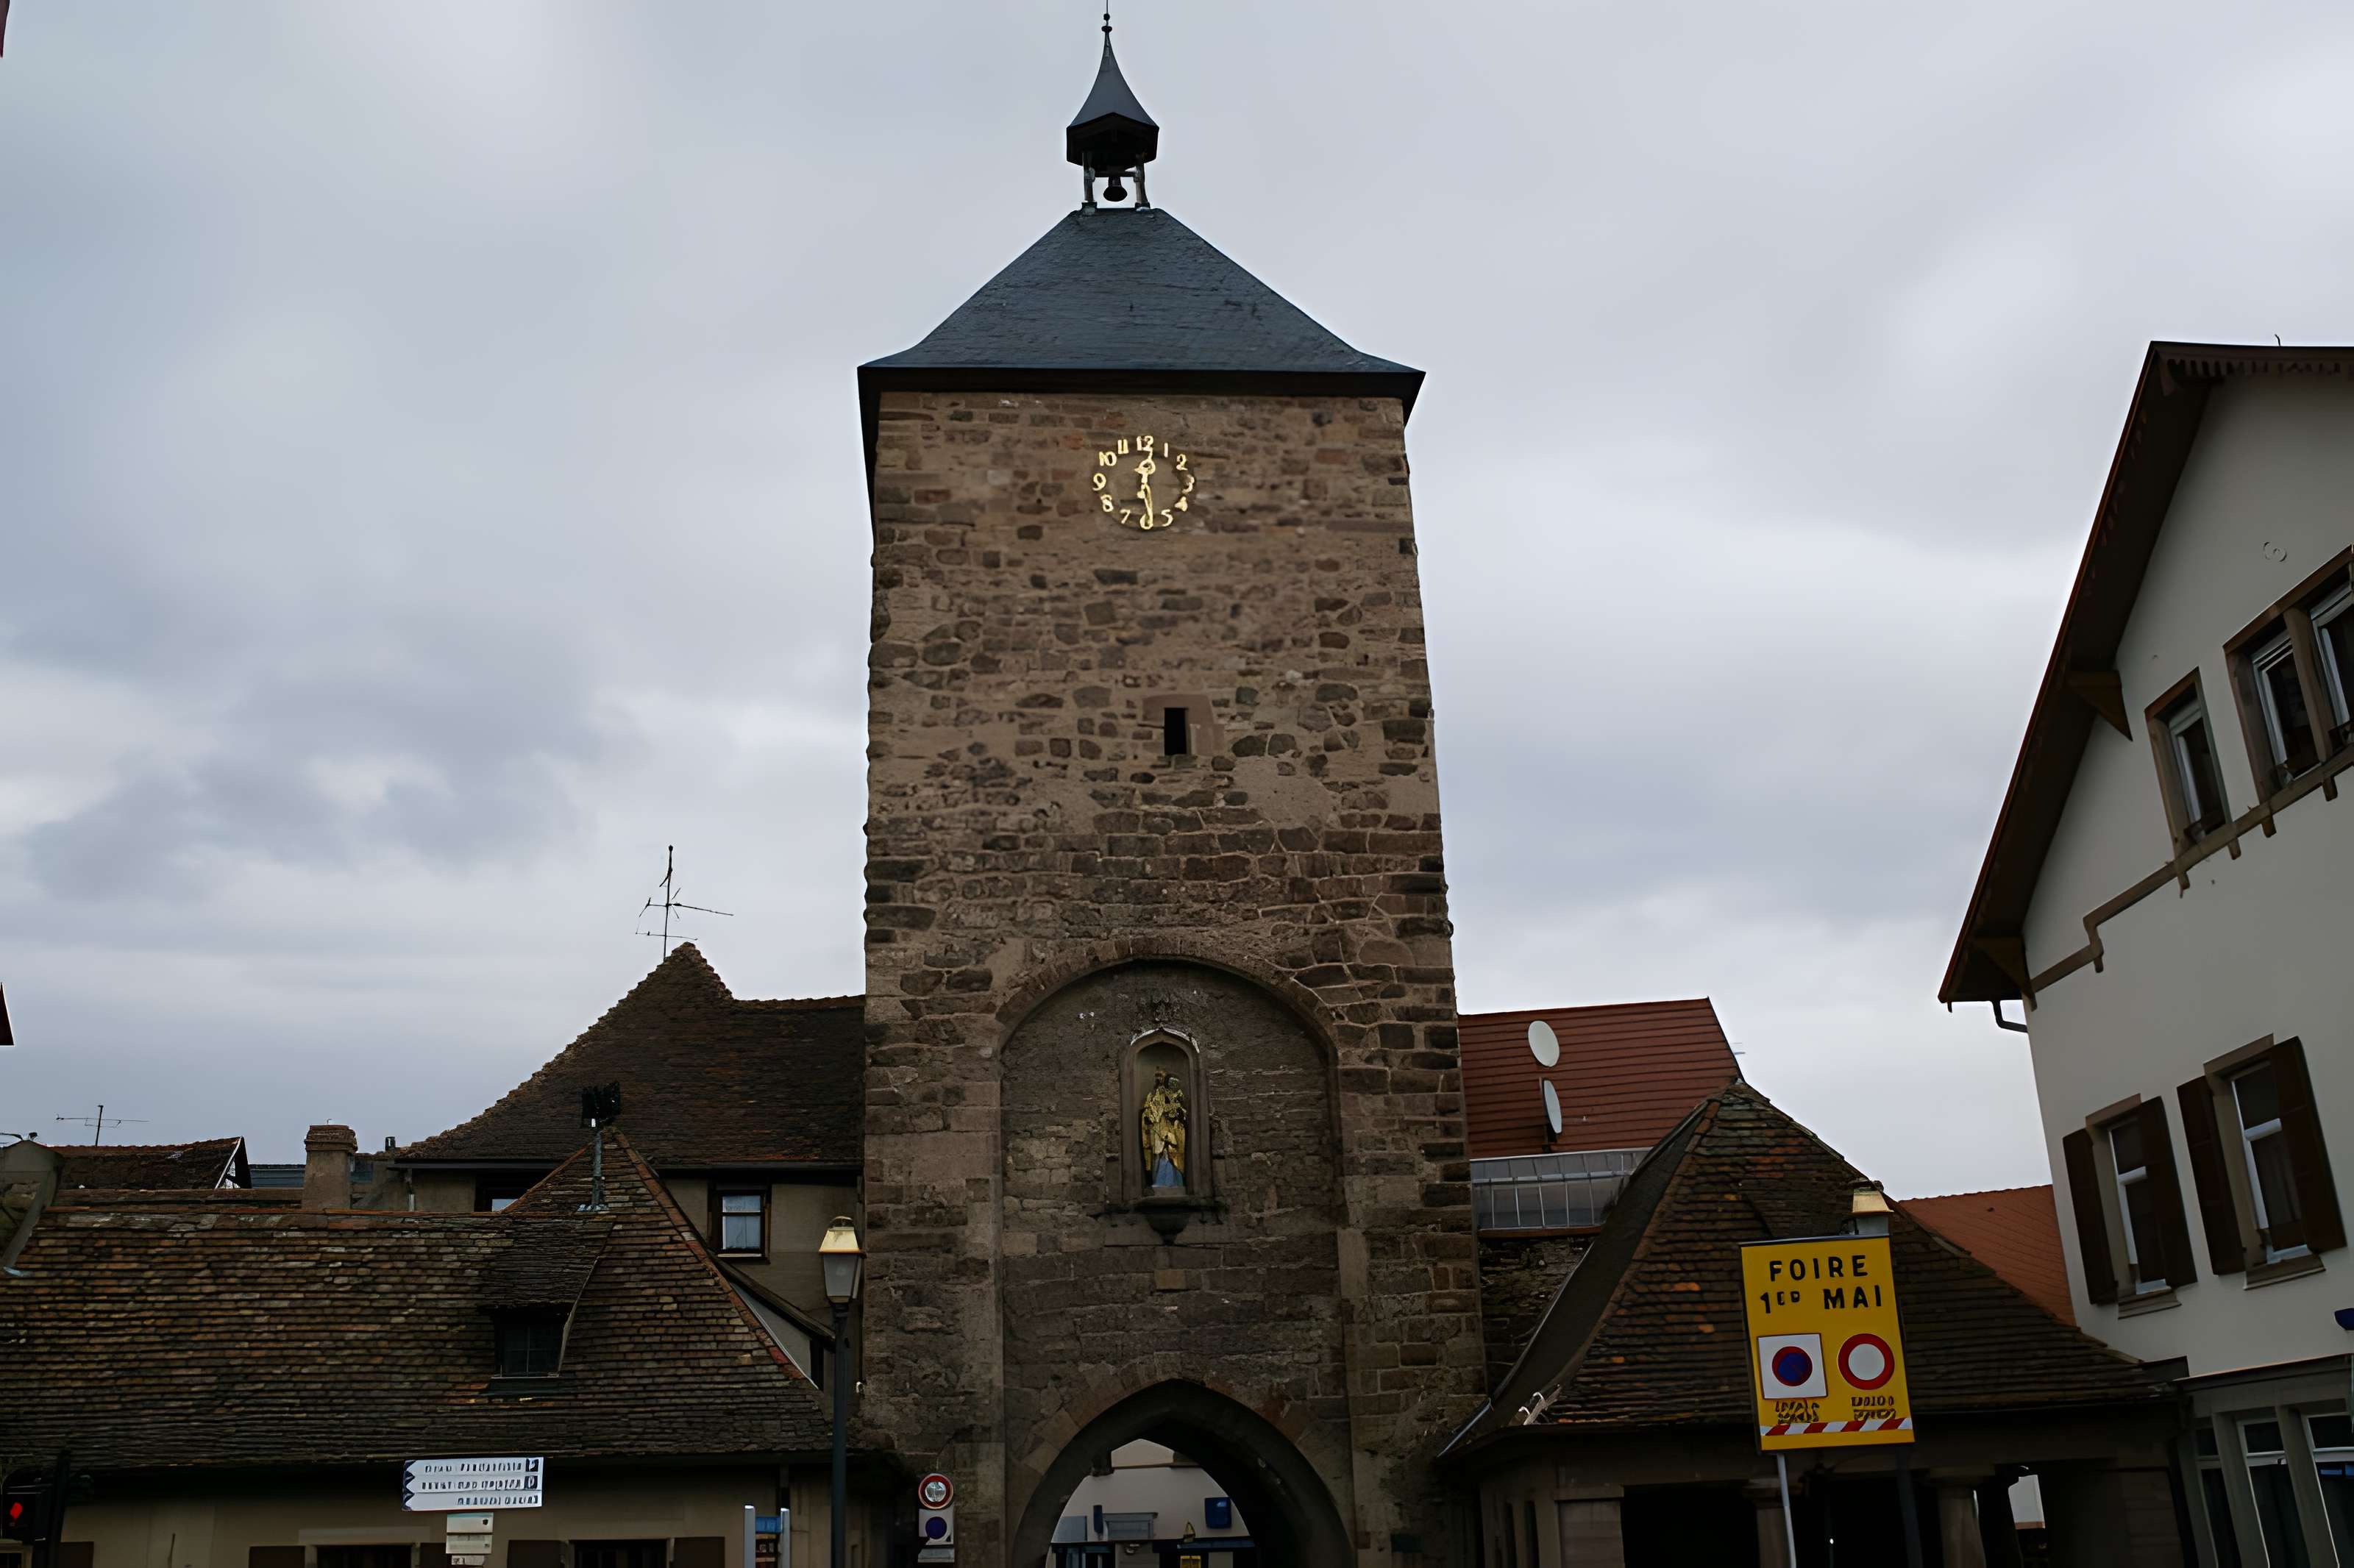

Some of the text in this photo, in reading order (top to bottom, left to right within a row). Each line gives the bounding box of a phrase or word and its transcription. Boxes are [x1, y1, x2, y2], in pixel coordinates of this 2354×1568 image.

[1117, 438, 1129, 455] 11
[1136, 435, 1154, 452] 12
[1164, 442, 1169, 457] 1
[1098, 451, 1117, 466] 10
[1176, 453, 1188, 471] 2
[1092, 472, 1107, 491] 9
[1181, 474, 1195, 493] 3
[1100, 494, 1114, 513] 8
[1174, 496, 1188, 512] 4
[1120, 509, 1131, 524] 7
[1161, 509, 1174, 527] 5
[1768, 1254, 1868, 1282] FOIRE
[1822, 1284, 1882, 1310] MAI
